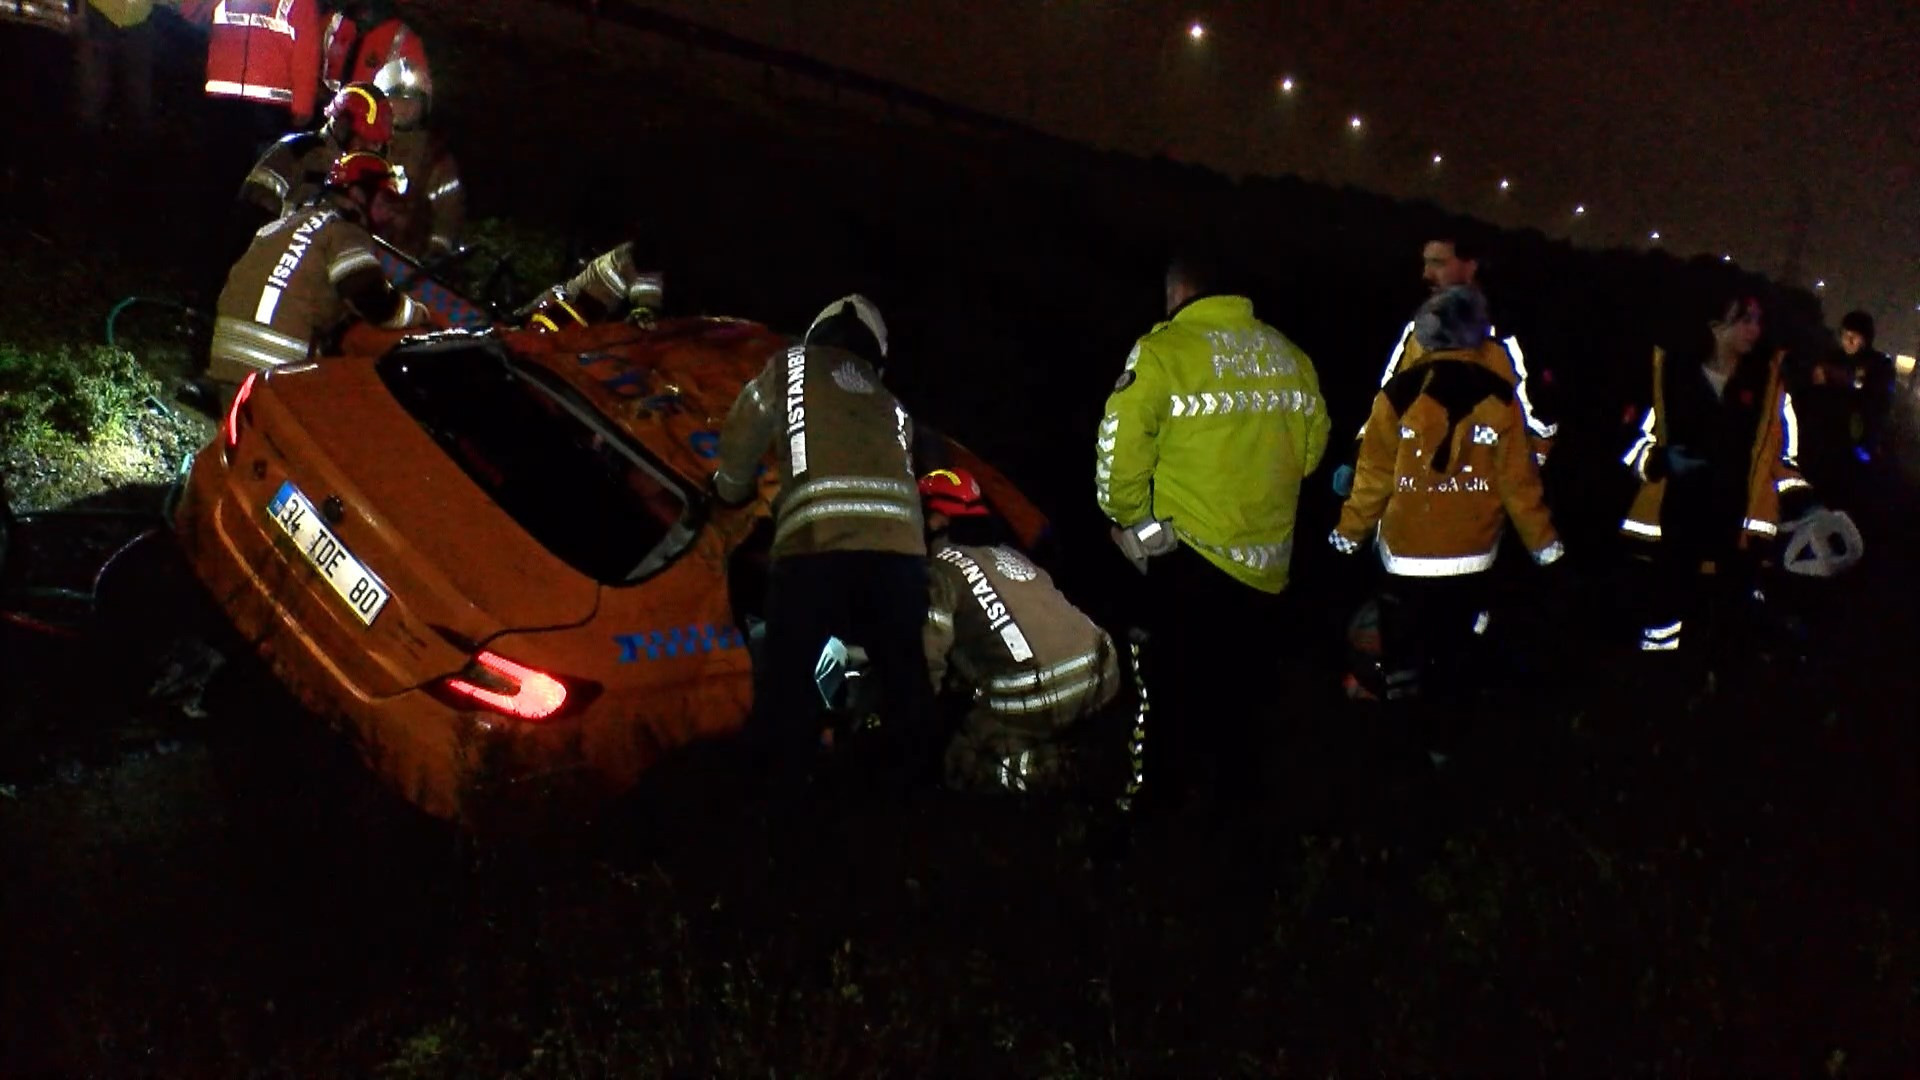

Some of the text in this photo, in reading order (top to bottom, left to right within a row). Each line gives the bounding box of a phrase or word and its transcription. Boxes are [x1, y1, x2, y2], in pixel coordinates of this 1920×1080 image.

[787, 344, 806, 436] İSTANBU
[280, 498, 380, 615] 34 TDE 80
